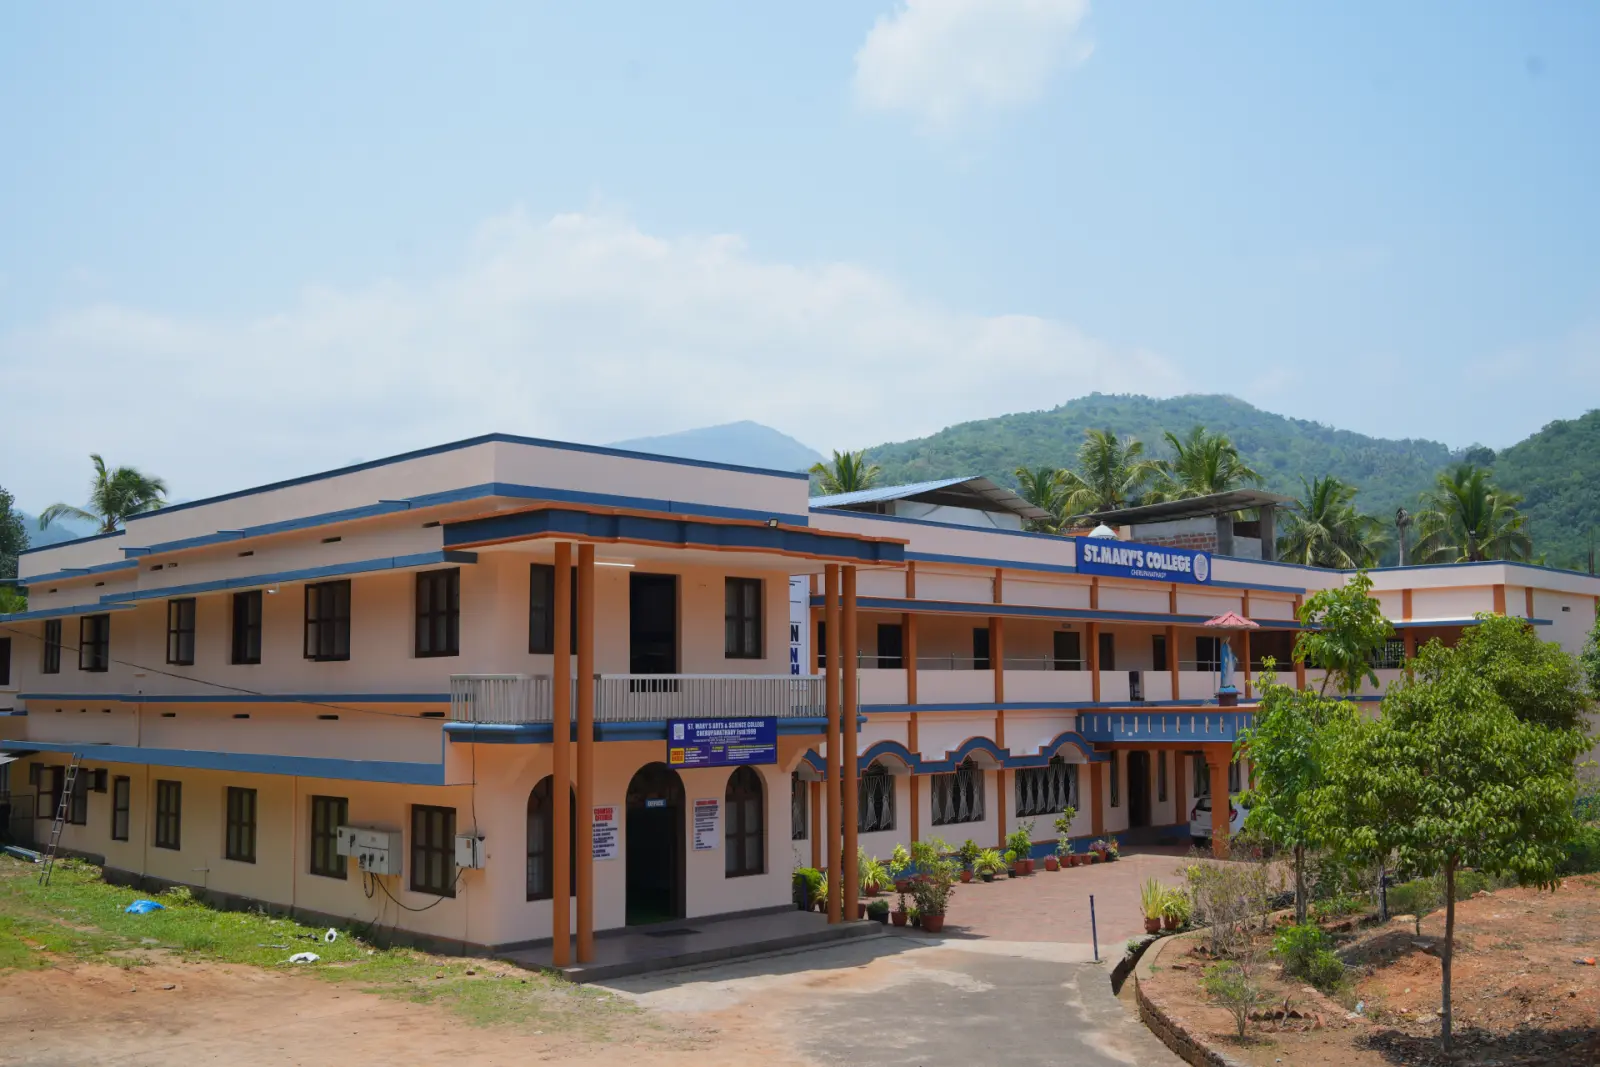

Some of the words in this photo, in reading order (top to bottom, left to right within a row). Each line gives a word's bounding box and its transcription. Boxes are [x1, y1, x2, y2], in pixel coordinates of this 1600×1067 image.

[1084, 544, 1144, 568] ST.MARY'S
[1146, 551, 1191, 572] COLLEGE
[728, 721, 747, 729] SCIENCE
